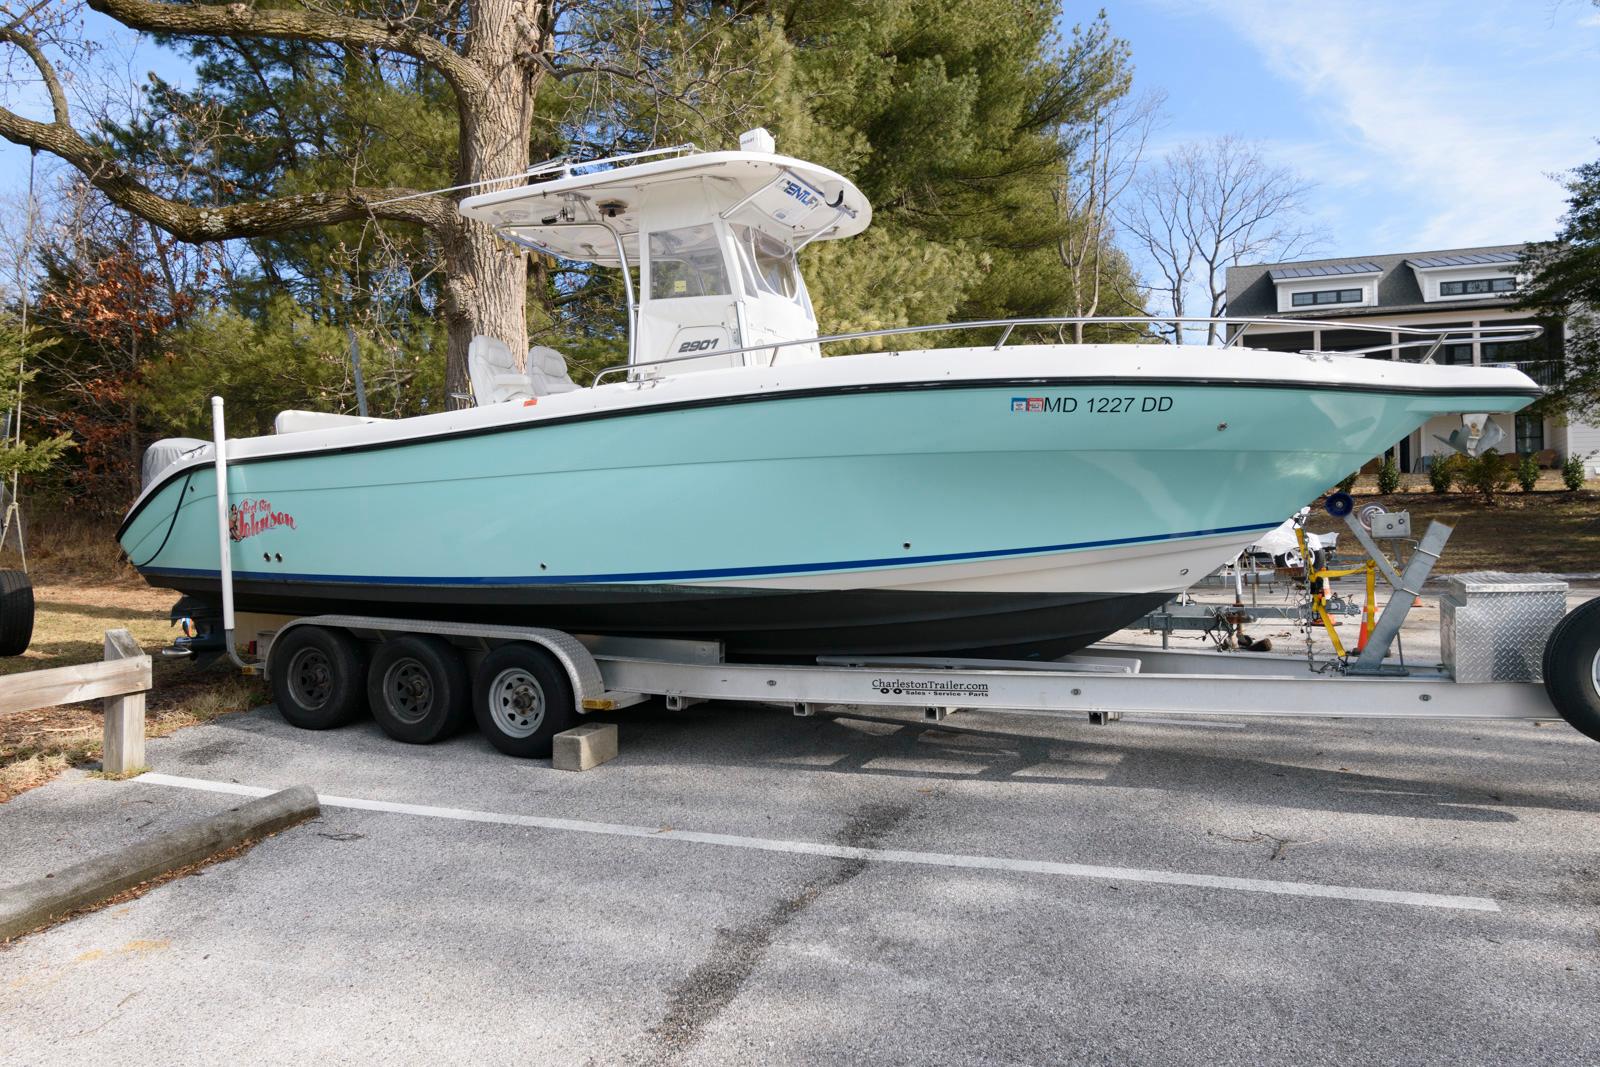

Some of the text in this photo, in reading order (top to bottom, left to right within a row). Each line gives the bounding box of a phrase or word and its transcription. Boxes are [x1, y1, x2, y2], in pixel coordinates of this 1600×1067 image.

[678, 338, 719, 353] 2901
[1043, 397, 1078, 413] MD
[1087, 397, 1135, 413] 1227
[1141, 396, 1174, 412] DD
[237, 510, 297, 537] Johnson
[872, 678, 988, 691] CharlestonTrailer.com
